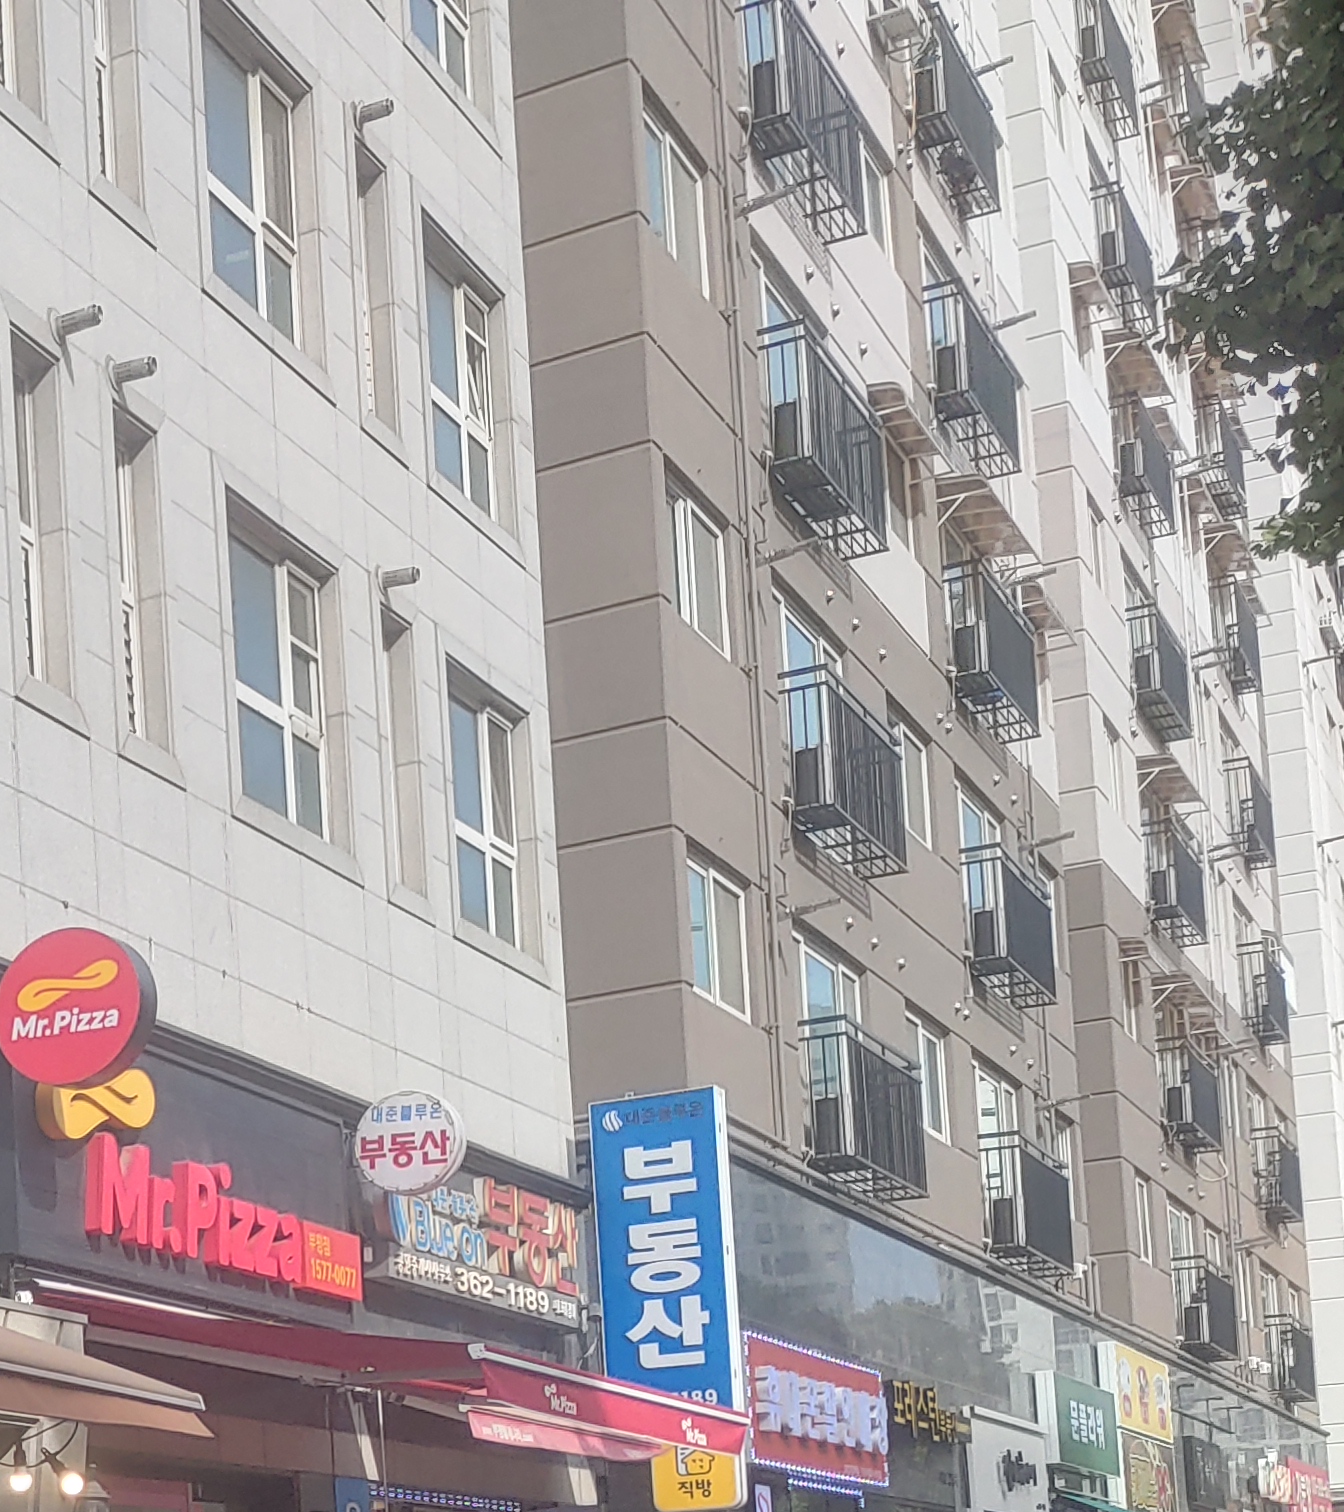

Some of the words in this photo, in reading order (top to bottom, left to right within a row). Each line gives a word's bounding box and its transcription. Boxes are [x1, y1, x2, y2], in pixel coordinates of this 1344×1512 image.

[11, 1007, 119, 1041] Mr.Pizza
[371, 1102, 443, 1124] 대준블루온
[359, 1129, 451, 1170] 부동산
[84, 1132, 304, 1284] Mr.Pizza
[411, 1196, 456, 1262] Blue
[476, 1175, 580, 1297] 부동산
[623, 1138, 711, 1370] 부동산
[310, 1257, 357, 1289] 1577-0077
[454, 1266, 550, 1314] 362-1189
[677, 1480, 712, 1498] 직방
